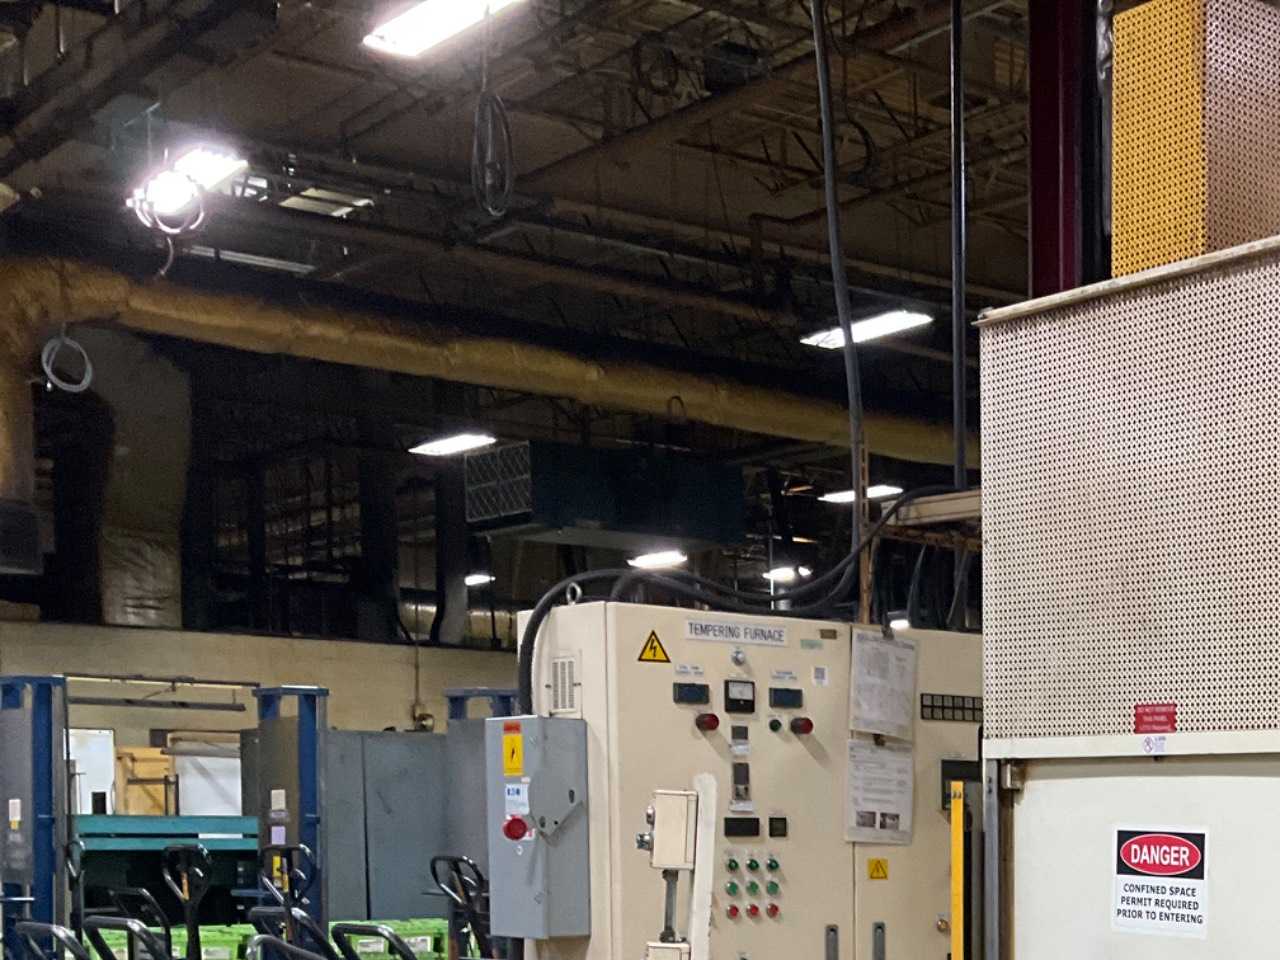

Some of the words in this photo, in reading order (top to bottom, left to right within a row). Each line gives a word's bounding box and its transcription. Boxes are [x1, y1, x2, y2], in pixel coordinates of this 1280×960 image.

[688, 622, 740, 639] TEMPERING
[743, 626, 784, 641] FURNACE
[1130, 844, 1190, 867] DANGER
[1123, 883, 1167, 895] CONFINED
[1169, 886, 1197, 897] SPACE
[1120, 896, 1152, 907] PERMIT
[1154, 898, 1199, 910] REQUIRED
[1116, 908, 1143, 919] PRIOR
[1145, 911, 1157, 920] TO
[1158, 911, 1204, 924] ENTERING
